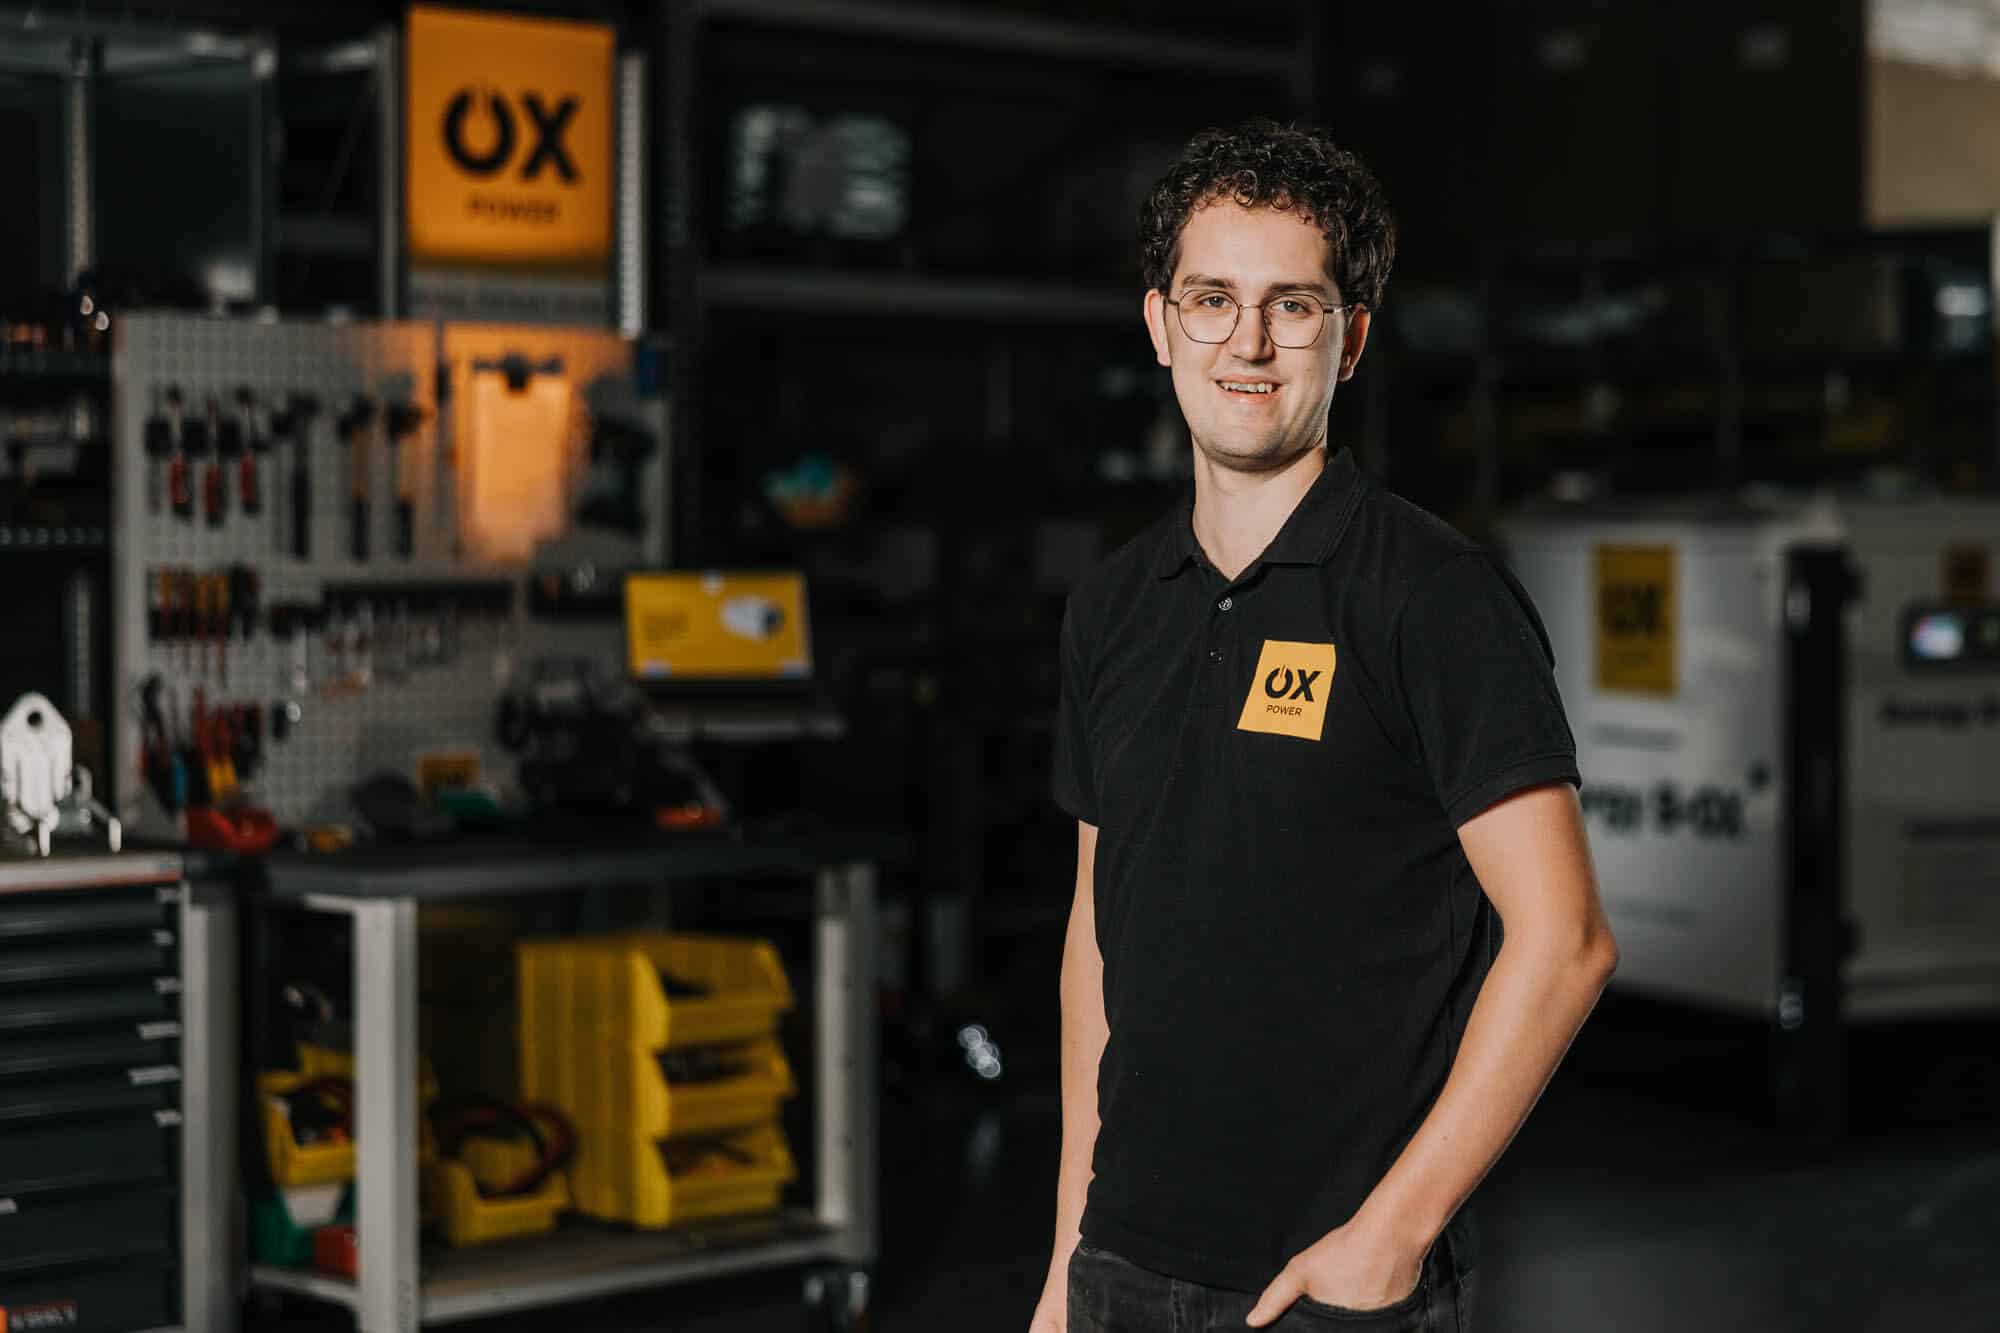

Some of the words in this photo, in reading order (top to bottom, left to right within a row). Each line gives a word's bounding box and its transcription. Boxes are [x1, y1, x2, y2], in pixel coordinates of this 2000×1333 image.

[443, 86, 580, 184] OX
[467, 193, 560, 226] POWER
[1265, 665, 1323, 702] OX
[1266, 704, 1303, 716] POWER
